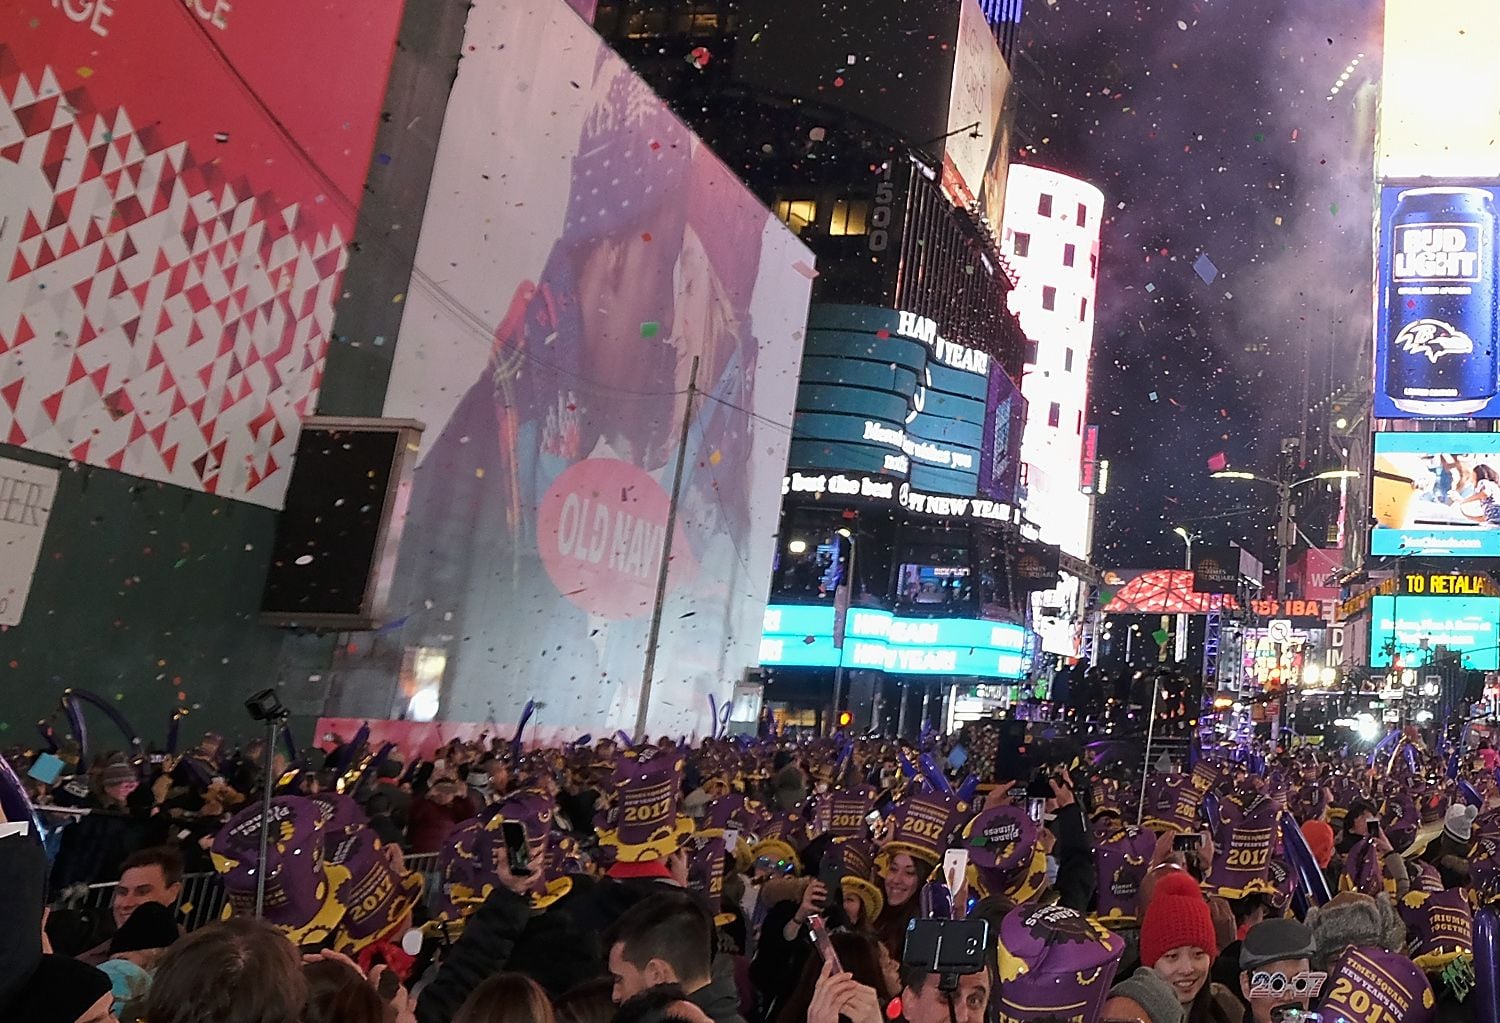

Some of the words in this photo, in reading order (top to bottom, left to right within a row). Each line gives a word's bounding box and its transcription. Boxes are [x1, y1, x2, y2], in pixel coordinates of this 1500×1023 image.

[868, 160, 893, 252] 1500
[1403, 228, 1466, 253] BUD
[1395, 251, 1478, 278] LIGHT
[558, 492, 609, 564] OLD
[608, 510, 666, 578] NAV
[1406, 575, 1424, 594] TO
[624, 798, 672, 823] 2017
[832, 814, 863, 827] 2017
[903, 816, 943, 840] 2017
[1226, 849, 1269, 865] 2017
[350, 875, 393, 922] 2017
[1341, 966, 1361, 982] NEW
[1387, 1001, 1405, 1022] EVE
[1346, 957, 1377, 982] TIMES
[1376, 976, 1410, 1012] SQUARE
